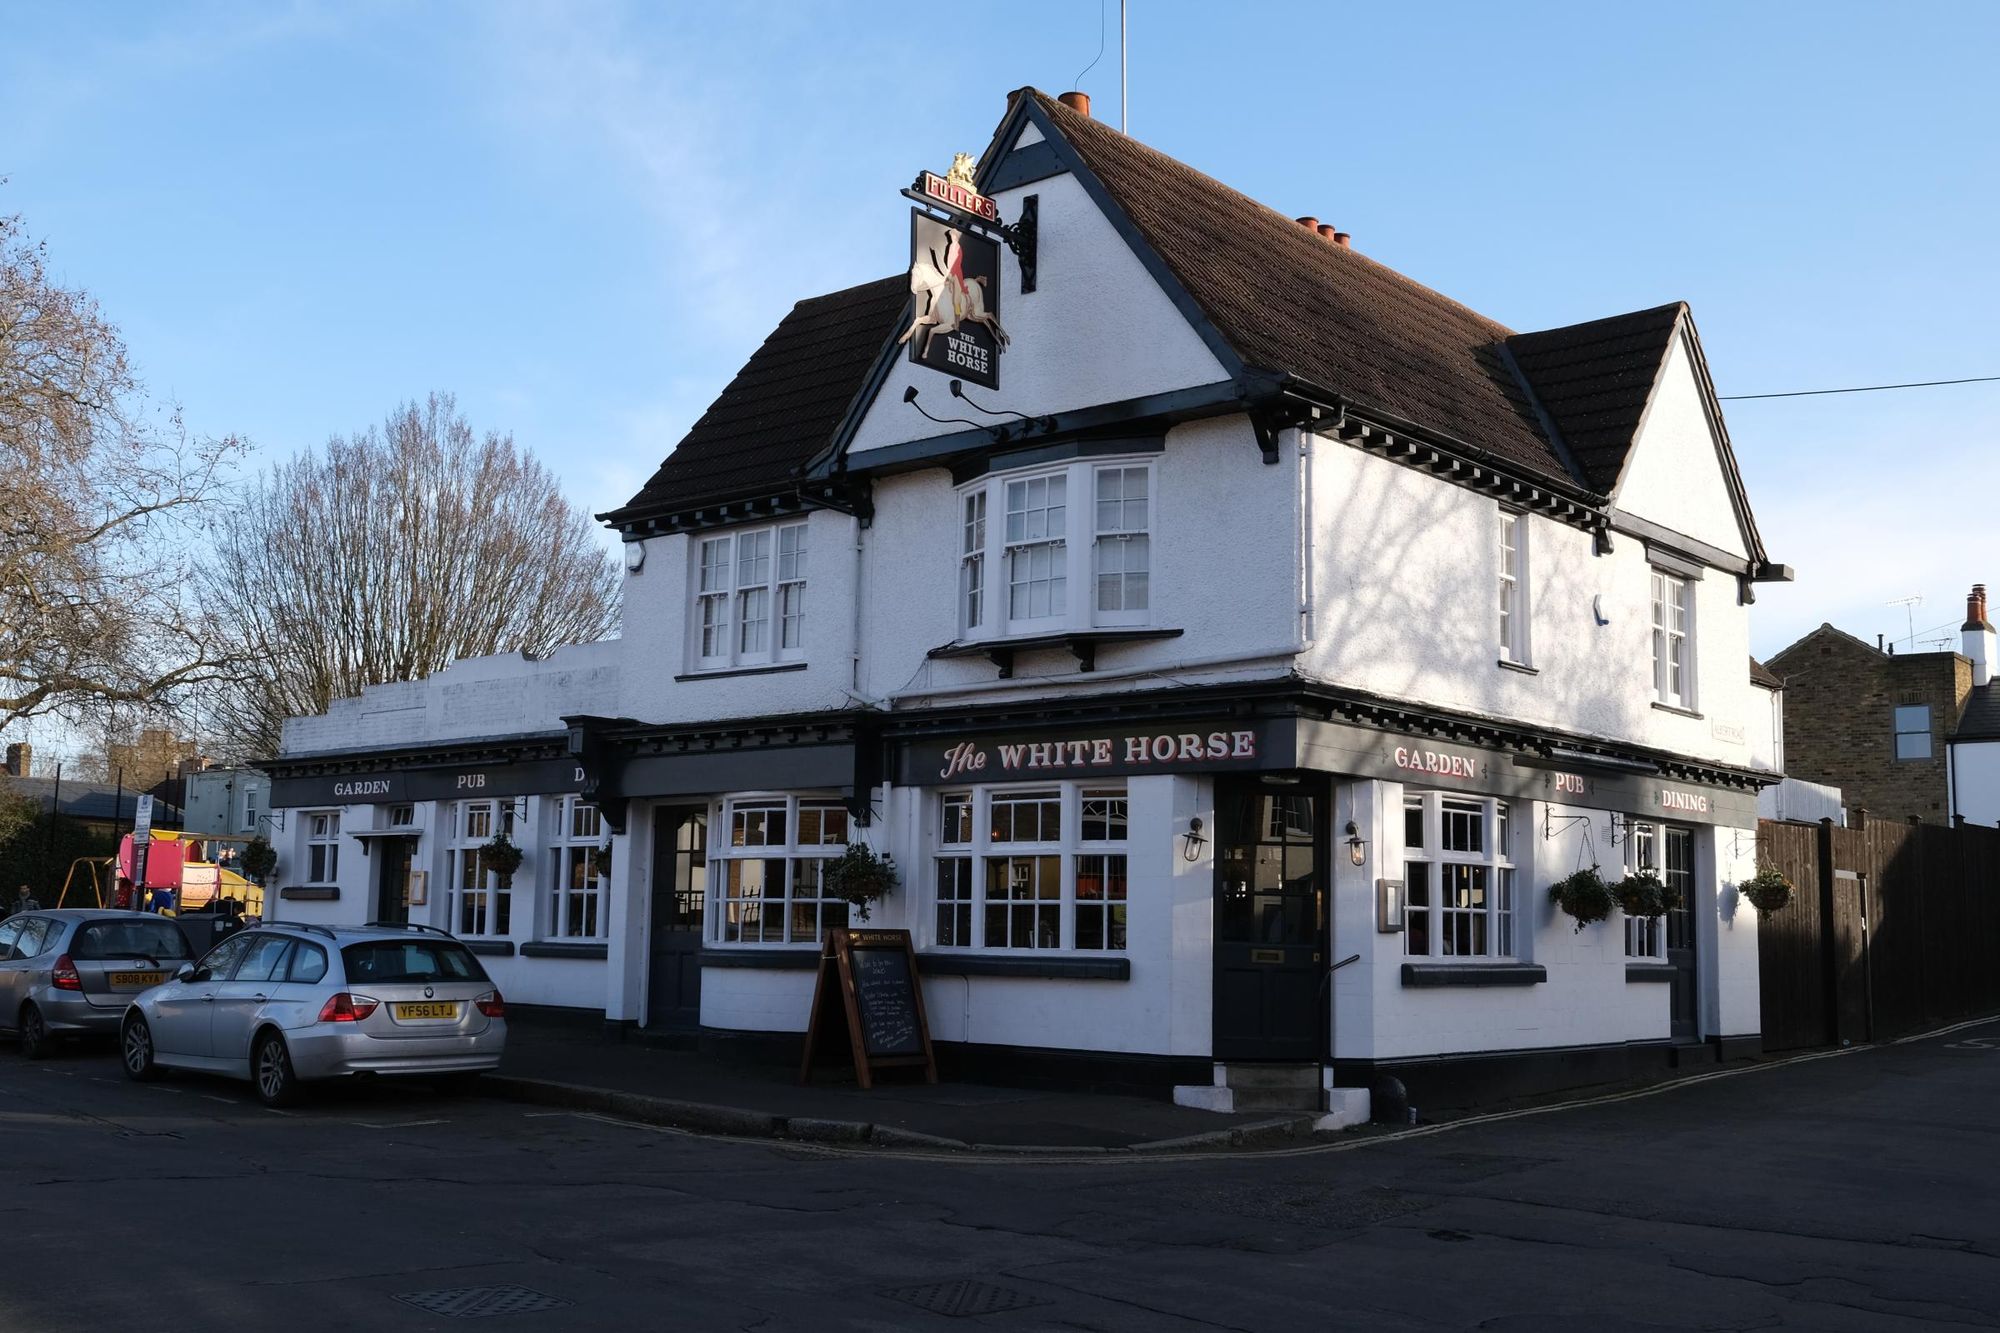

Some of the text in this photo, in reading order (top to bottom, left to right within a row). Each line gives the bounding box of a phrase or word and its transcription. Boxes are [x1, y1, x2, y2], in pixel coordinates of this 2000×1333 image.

[928, 176, 993, 217] FULLER'S
[947, 336, 988, 361] WHITE
[960, 332, 975, 344] THE
[947, 350, 988, 374] HORSE
[940, 730, 1255, 779] The WHITE HORSE
[1394, 747, 1475, 778] GARDEN
[334, 780, 390, 796] GARDEN
[457, 774, 486, 789] PUB
[1555, 773, 1585, 795] PUB
[1662, 790, 1707, 813] DINING
[400, 1006, 429, 1017] YF56
